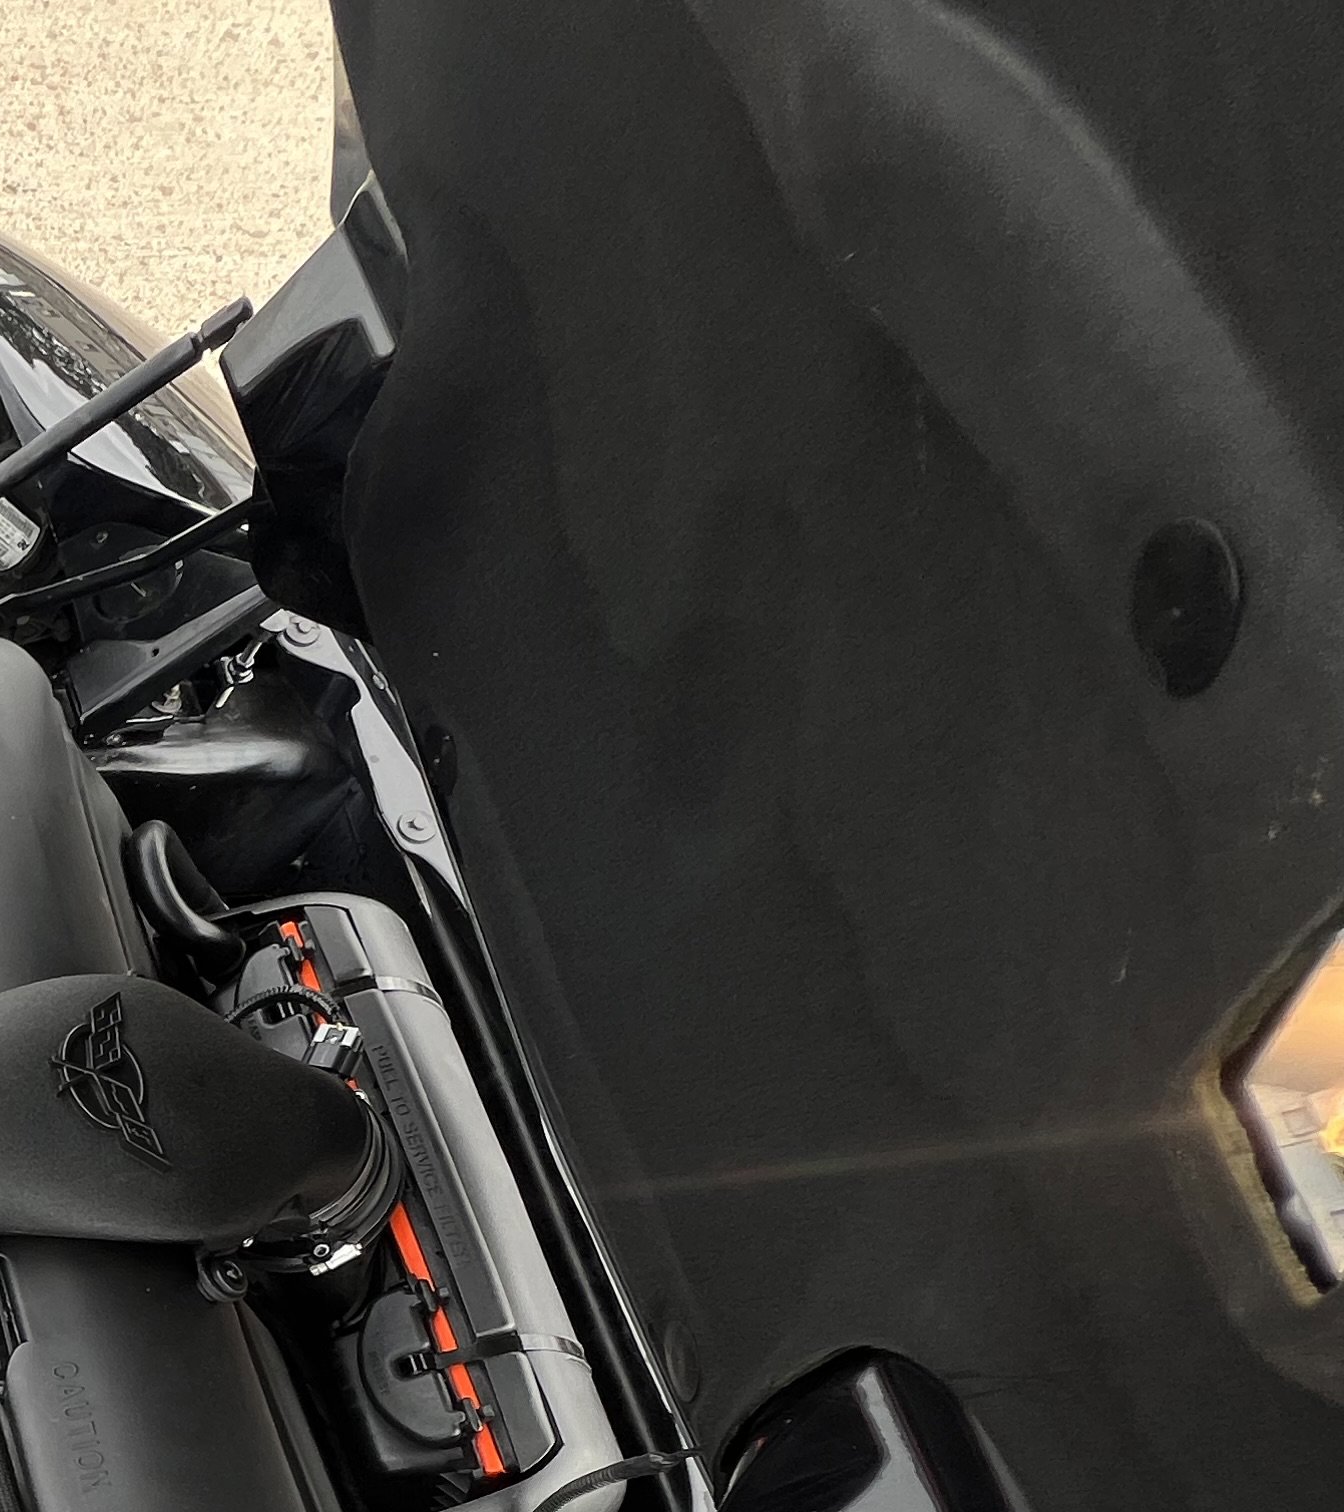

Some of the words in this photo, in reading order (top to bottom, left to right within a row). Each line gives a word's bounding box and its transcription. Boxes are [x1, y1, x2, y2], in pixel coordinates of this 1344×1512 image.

[371, 1045, 397, 1092] PULL
[390, 1094, 410, 1116] TO
[403, 1122, 445, 1200] SERVICE
[52, 1360, 112, 1494] CAUTION
